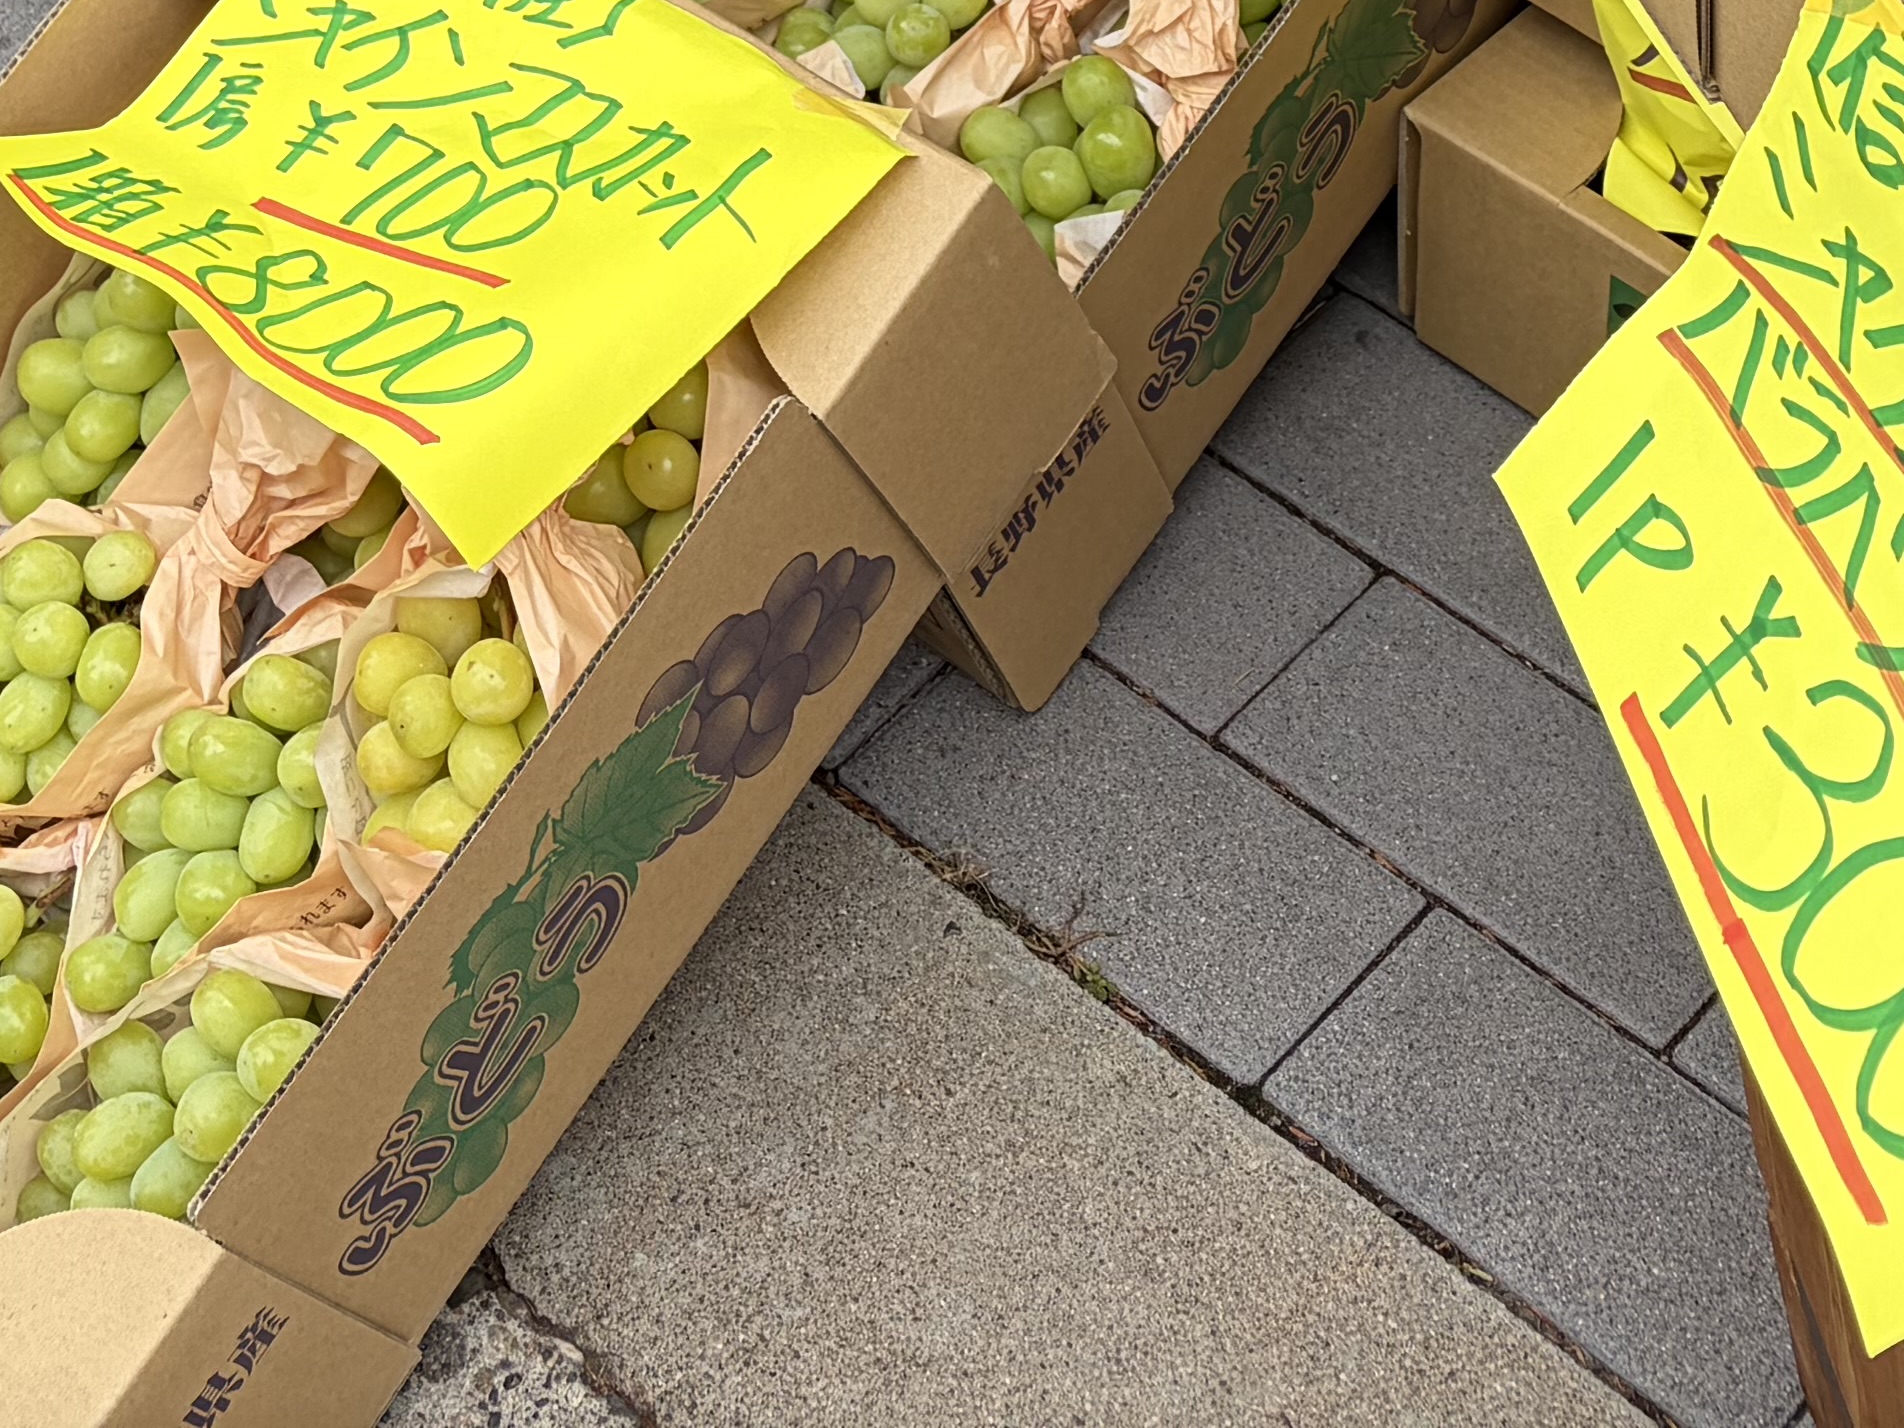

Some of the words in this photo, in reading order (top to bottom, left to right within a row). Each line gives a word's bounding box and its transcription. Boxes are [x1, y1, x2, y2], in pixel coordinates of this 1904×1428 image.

[276, 101, 558, 254] ¥700
[1138, 90, 1359, 414] ぶどう
[337, 871, 629, 1278] ぶどう
